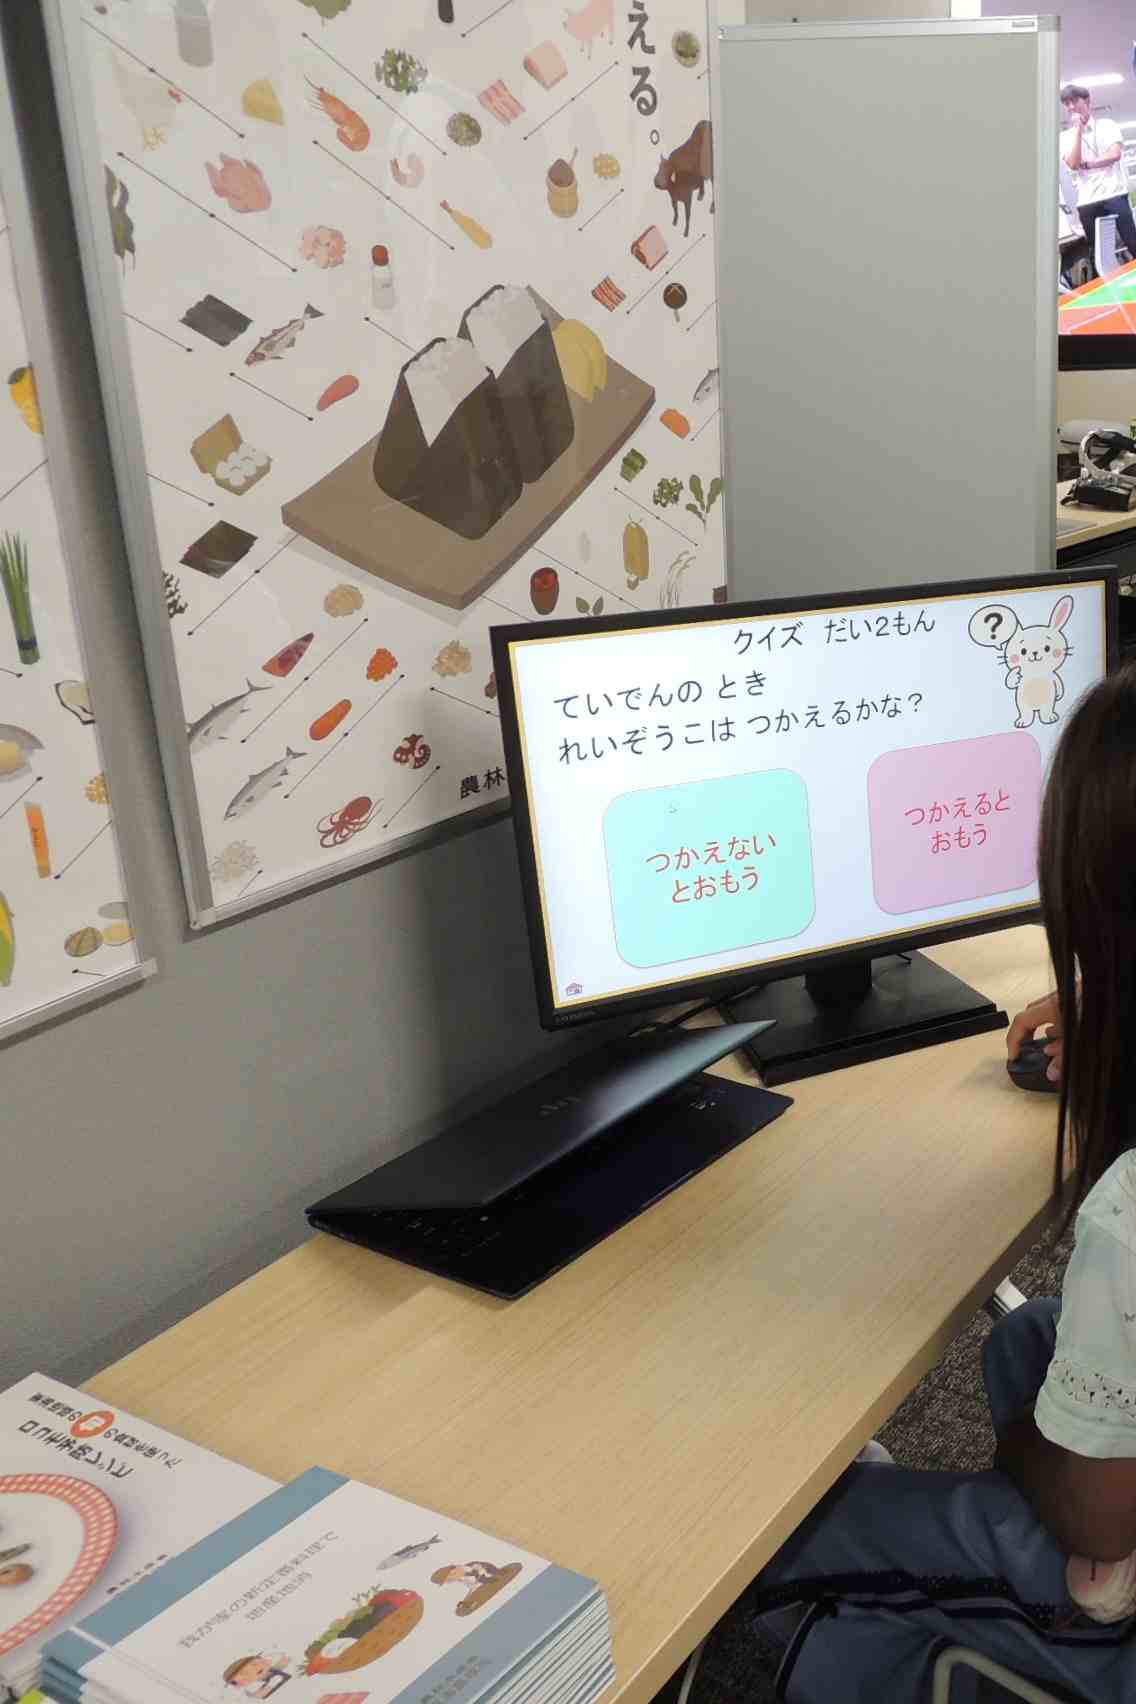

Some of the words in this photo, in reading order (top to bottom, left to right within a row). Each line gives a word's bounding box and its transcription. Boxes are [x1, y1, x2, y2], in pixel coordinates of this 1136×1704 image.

[627, 0, 660, 145] える。
[735, 624, 805, 655] クイズ
[826, 612, 936, 645] だい2もん
[554, 679, 702, 719] ていでんの
[716, 669, 769, 700] とき
[559, 719, 737, 765] れいぞうこは
[746, 691, 925, 735] つかえるかな?
[459, 766, 505, 799] 農林
[904, 787, 1011, 825] つかえると
[646, 831, 777, 874] つかえない
[930, 824, 989, 854] おもう
[672, 868, 760, 904] とおもう
